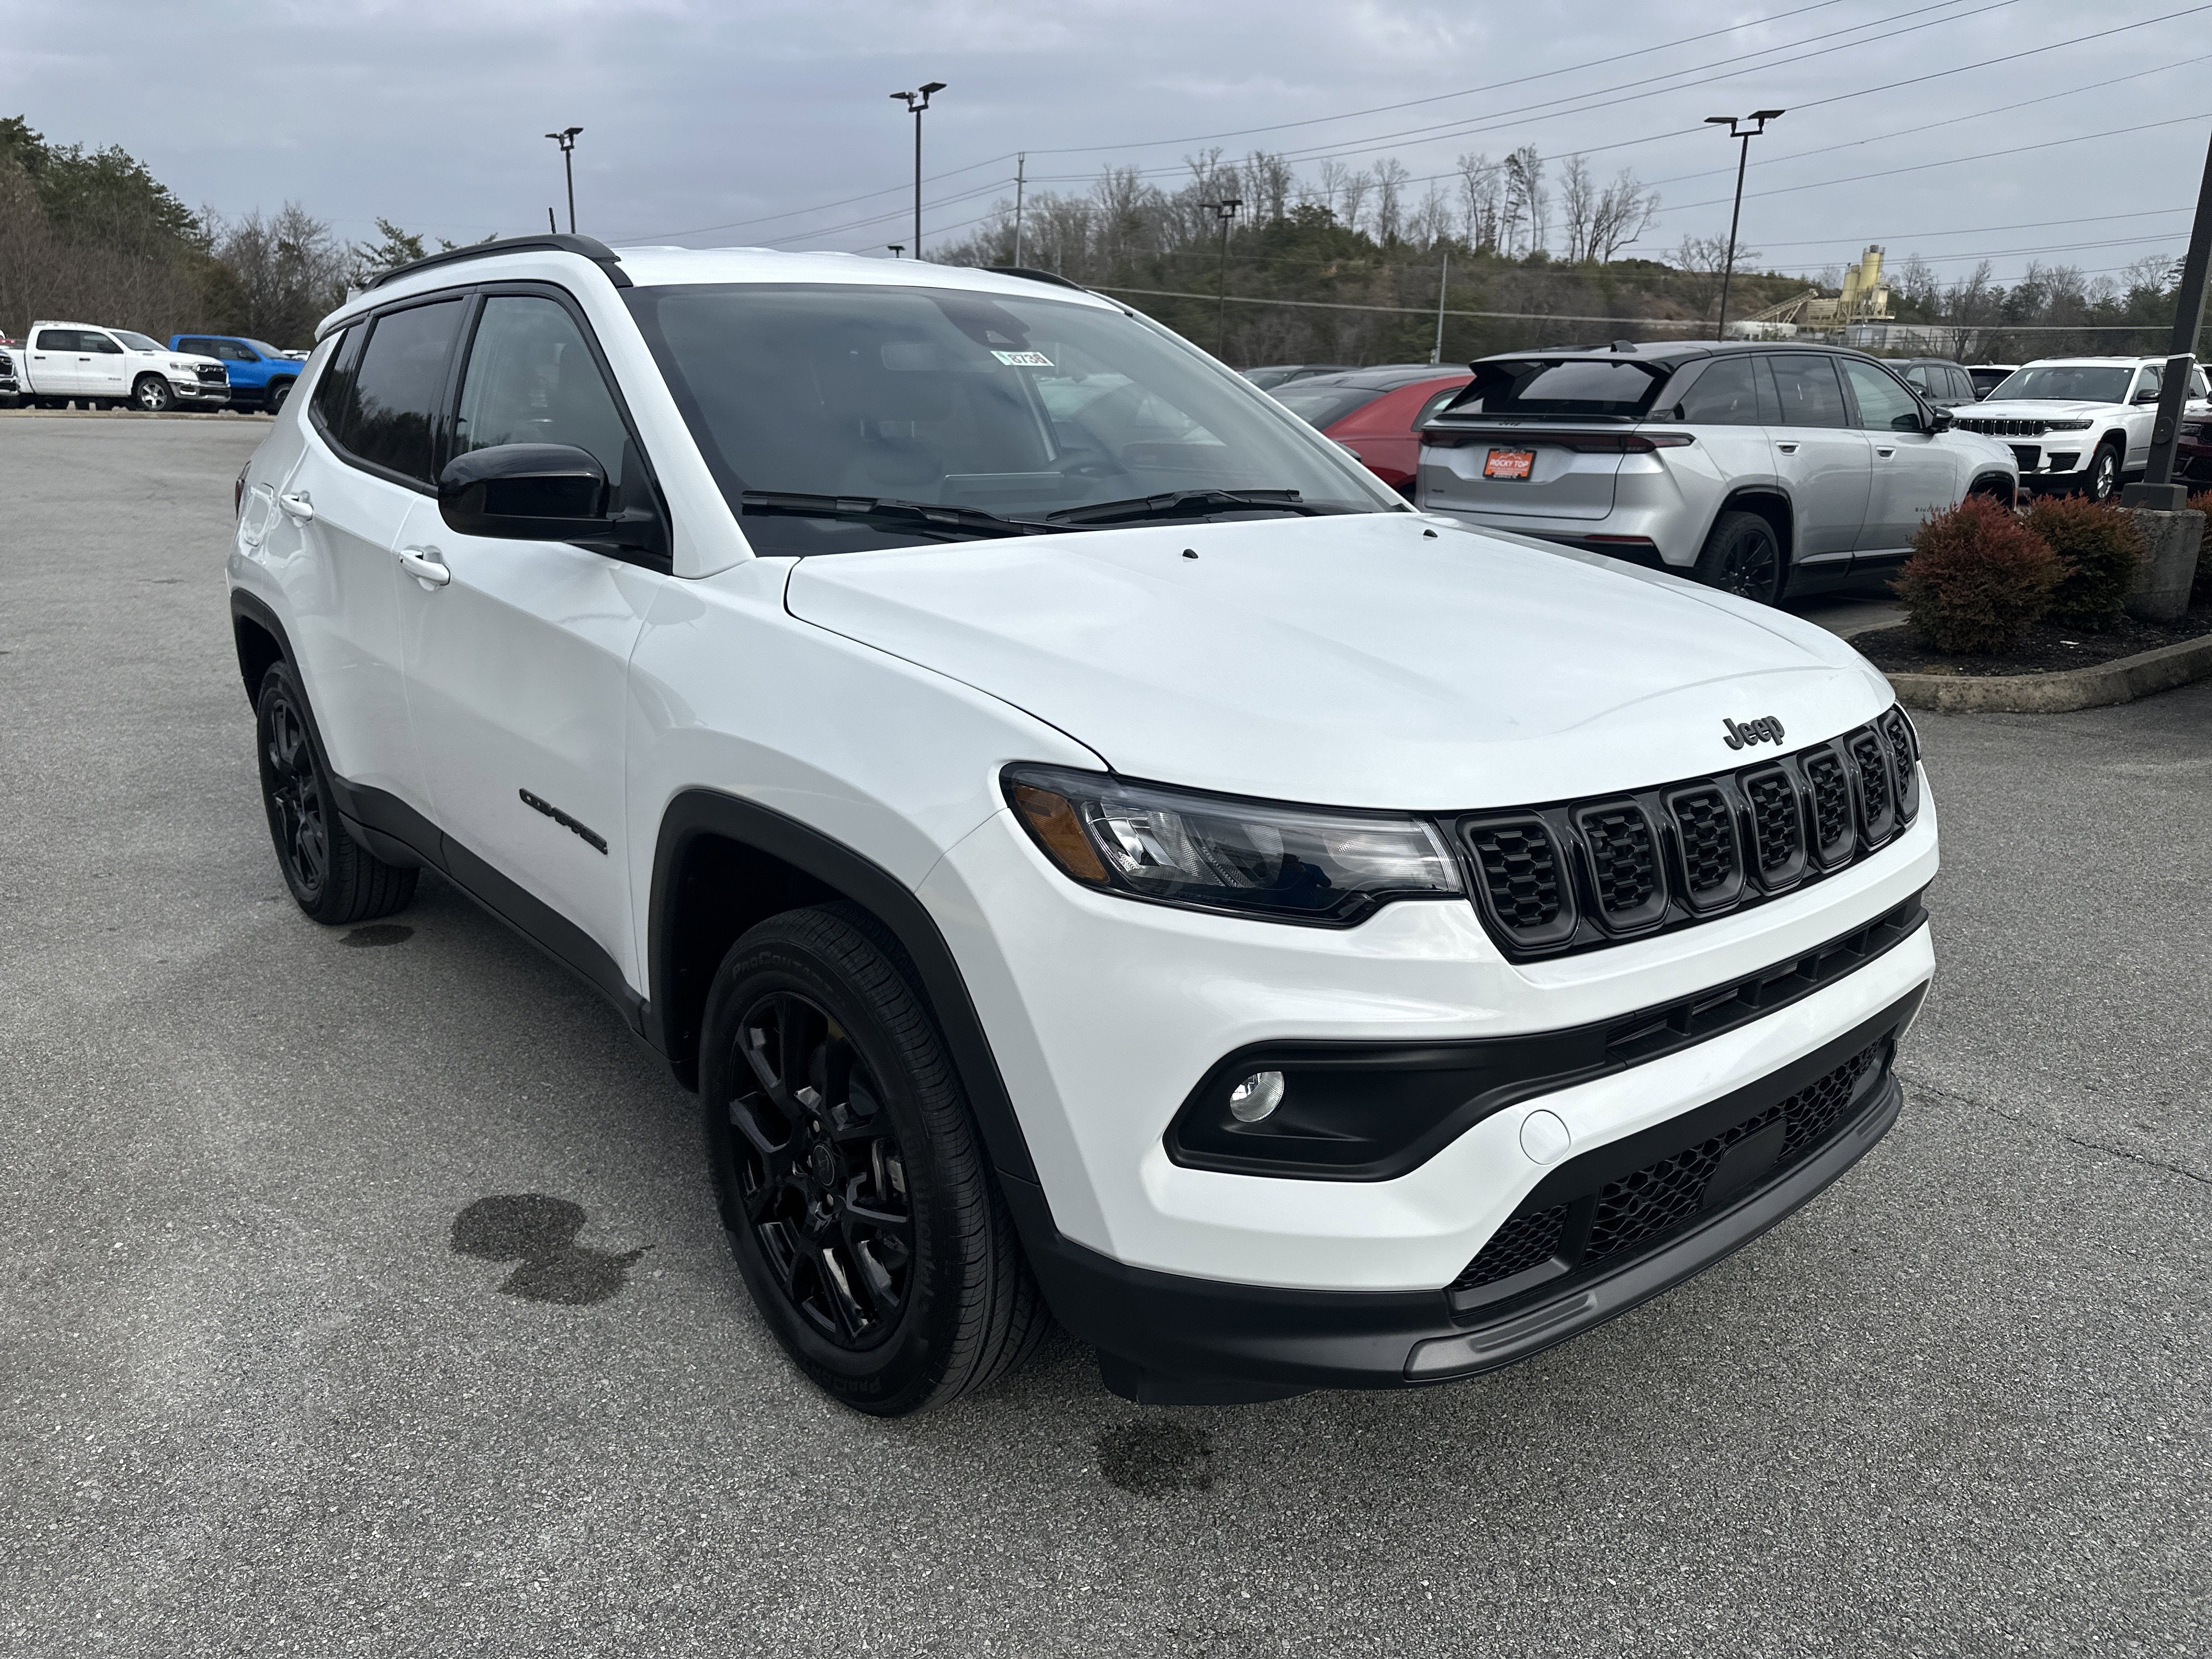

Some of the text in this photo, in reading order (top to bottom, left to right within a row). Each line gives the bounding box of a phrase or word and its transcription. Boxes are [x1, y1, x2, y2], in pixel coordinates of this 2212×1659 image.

[1007, 354, 1047, 364] 8736
[1489, 459, 1513, 467] ROCKY
[1723, 715, 1785, 751] Jeep
